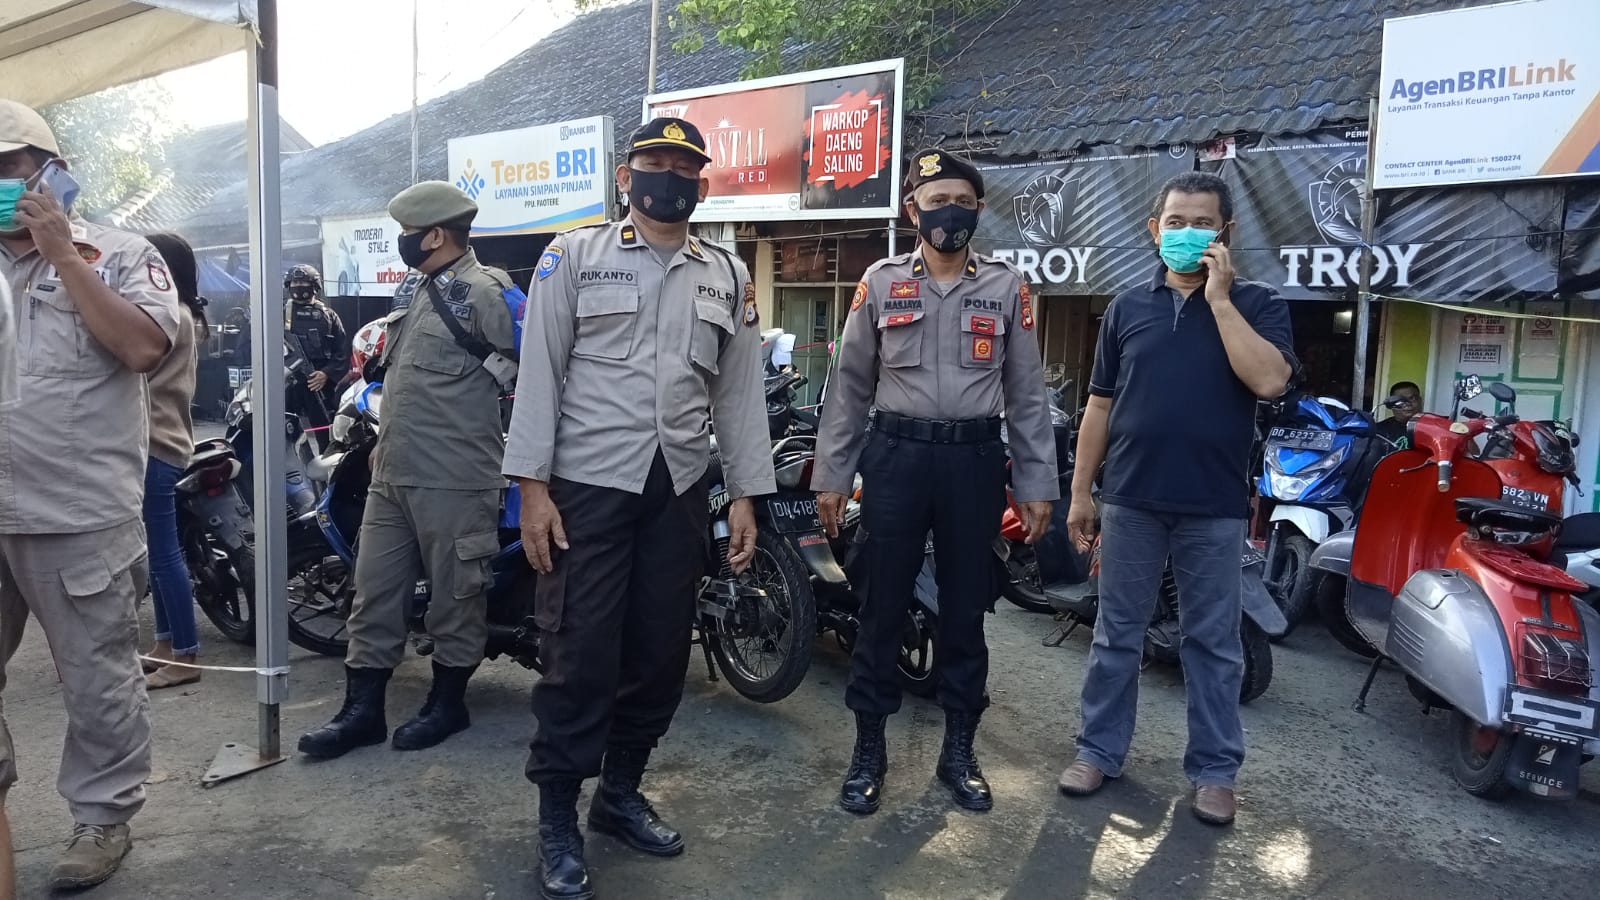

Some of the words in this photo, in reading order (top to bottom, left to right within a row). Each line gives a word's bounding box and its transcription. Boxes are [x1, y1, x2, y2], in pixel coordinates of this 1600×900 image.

[1388, 58, 1577, 104] AgenBRILink
[1387, 103, 1422, 114] Layanan
[1424, 99, 1463, 110] Transaksi
[1465, 94, 1510, 106] Keuangan
[1512, 91, 1540, 102] Tanpa
[1542, 88, 1576, 98] Kantor
[822, 109, 869, 131] WARKOP
[826, 132, 863, 153] DAENG
[1345, 130, 1369, 139] PERIN
[704, 128, 769, 170] YSTAL
[491, 160, 550, 186] Teras
[556, 147, 596, 178] BRI
[824, 153, 863, 174] SALING
[1384, 162, 1416, 170] CONTACT
[1417, 160, 1443, 168] CENTER
[1491, 154, 1521, 162] 1500274
[738, 170, 765, 184] RED
[494, 186, 529, 200] LAYANAN
[530, 183, 560, 197] SIMPAN
[561, 179, 592, 193] PINJAM
[537, 197, 560, 208] PAOTERE
[354, 228, 383, 241] MODERN
[368, 241, 390, 254] STYLE
[1279, 244, 1425, 287] TROY
[580, 270, 634, 282] RUKANTO
[884, 299, 923, 311] MASJAYA
[964, 298, 1002, 311] POLRI
[1271, 428, 1285, 437] DD
[1289, 430, 1315, 440] 6233
[1518, 770, 1565, 789] SERVICE
